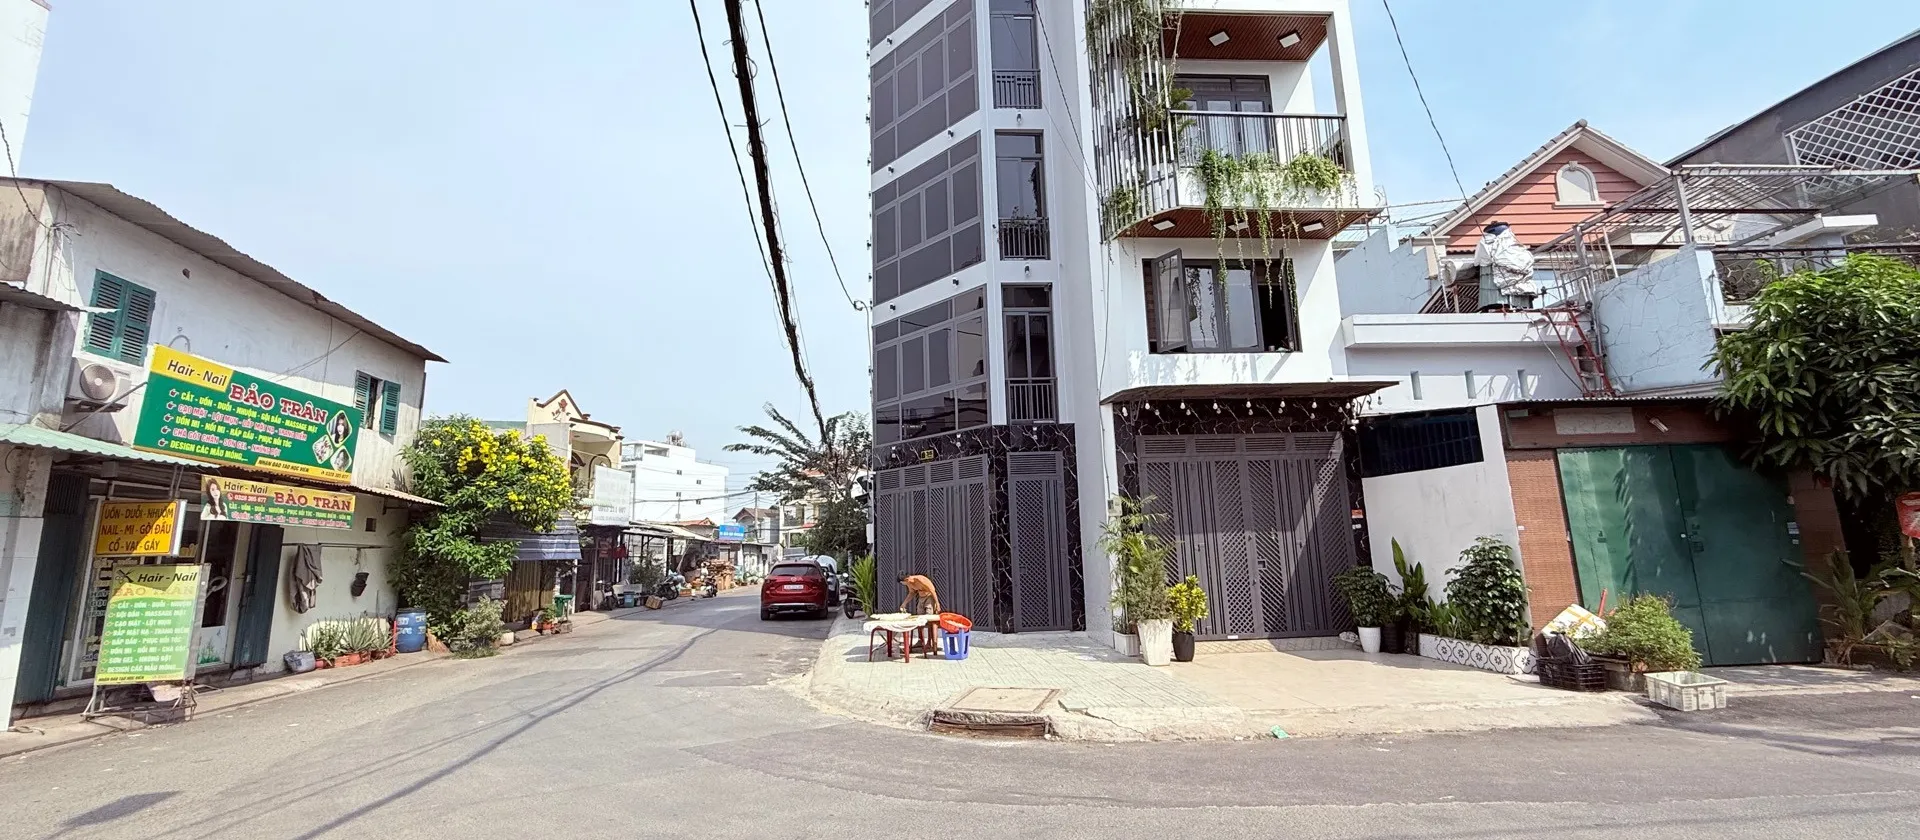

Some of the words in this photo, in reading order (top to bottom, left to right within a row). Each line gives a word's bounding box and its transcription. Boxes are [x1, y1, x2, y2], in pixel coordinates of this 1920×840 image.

[167, 359, 195, 377] Hair
[202, 370, 229, 386] Nail
[230, 383, 275, 410] BẢO
[280, 398, 328, 425] TRÂN
[170, 441, 195, 451] DESIGN
[195, 444, 209, 453] CÁC
[223, 480, 244, 491] Hair
[249, 484, 268, 494] Nail
[274, 488, 308, 506] BẢO
[313, 495, 351, 511] TRÂN
[101, 524, 119, 535] NAIL
[124, 525, 135, 535] MI
[125, 541, 138, 551] VAI
[144, 538, 160, 551] GÁY
[137, 573, 164, 582] Hair
[172, 572, 197, 581] Nail
